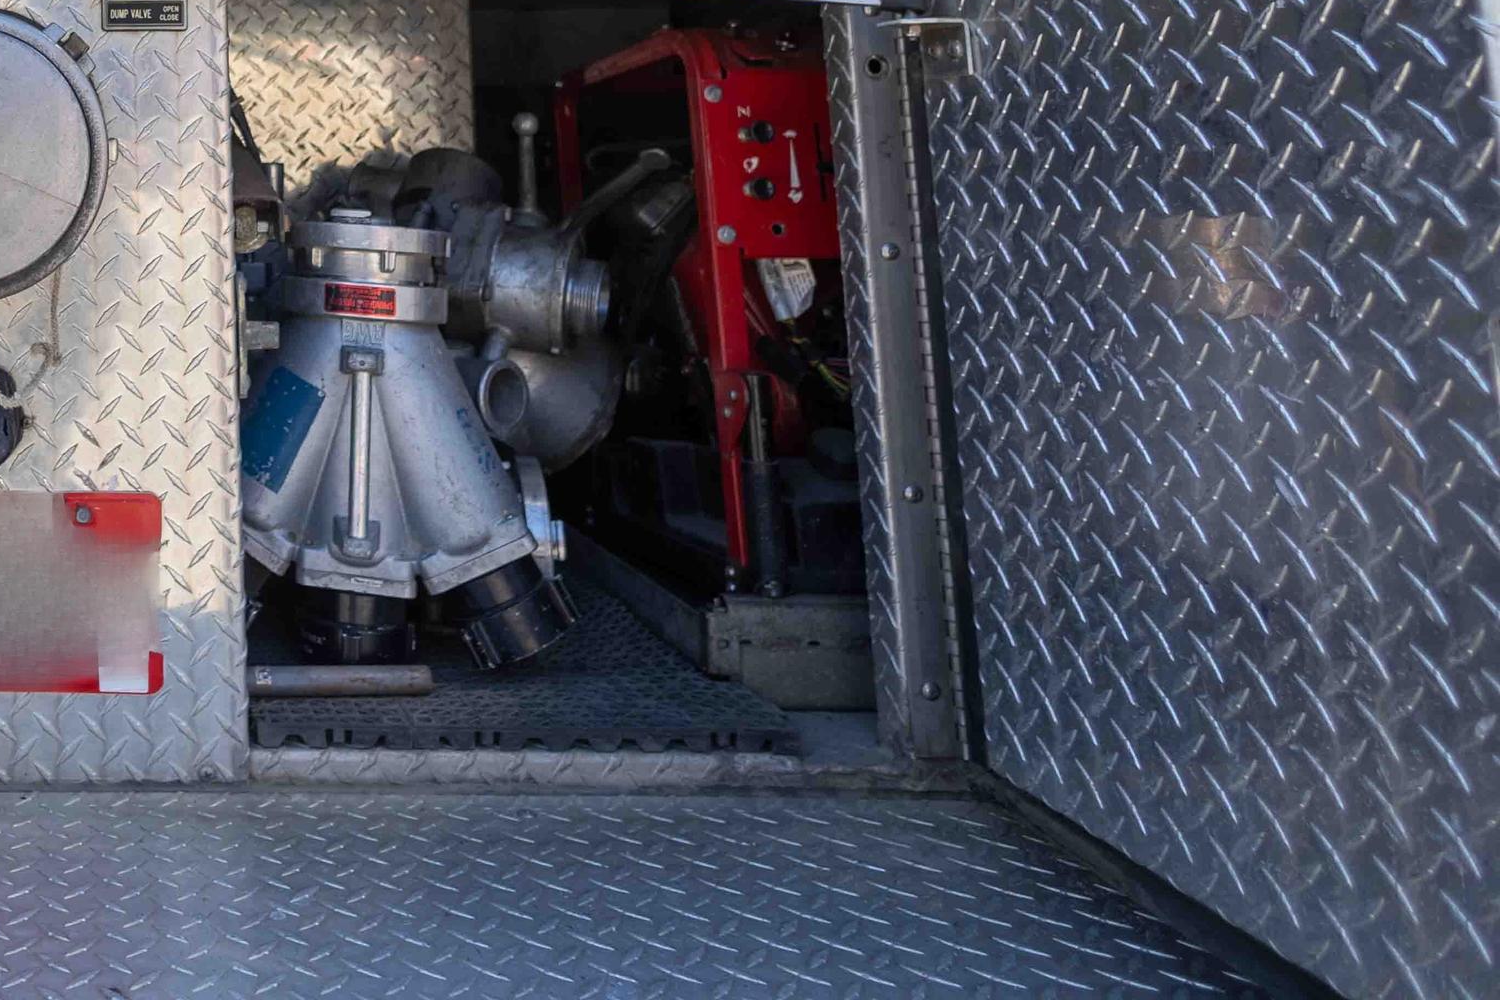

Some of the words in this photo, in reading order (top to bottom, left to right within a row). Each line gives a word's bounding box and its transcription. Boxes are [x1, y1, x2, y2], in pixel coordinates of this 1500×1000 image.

[110, 8, 129, 19] DUMP
[131, 8, 152, 19] VALVE
[162, 5, 180, 13] OPEN
